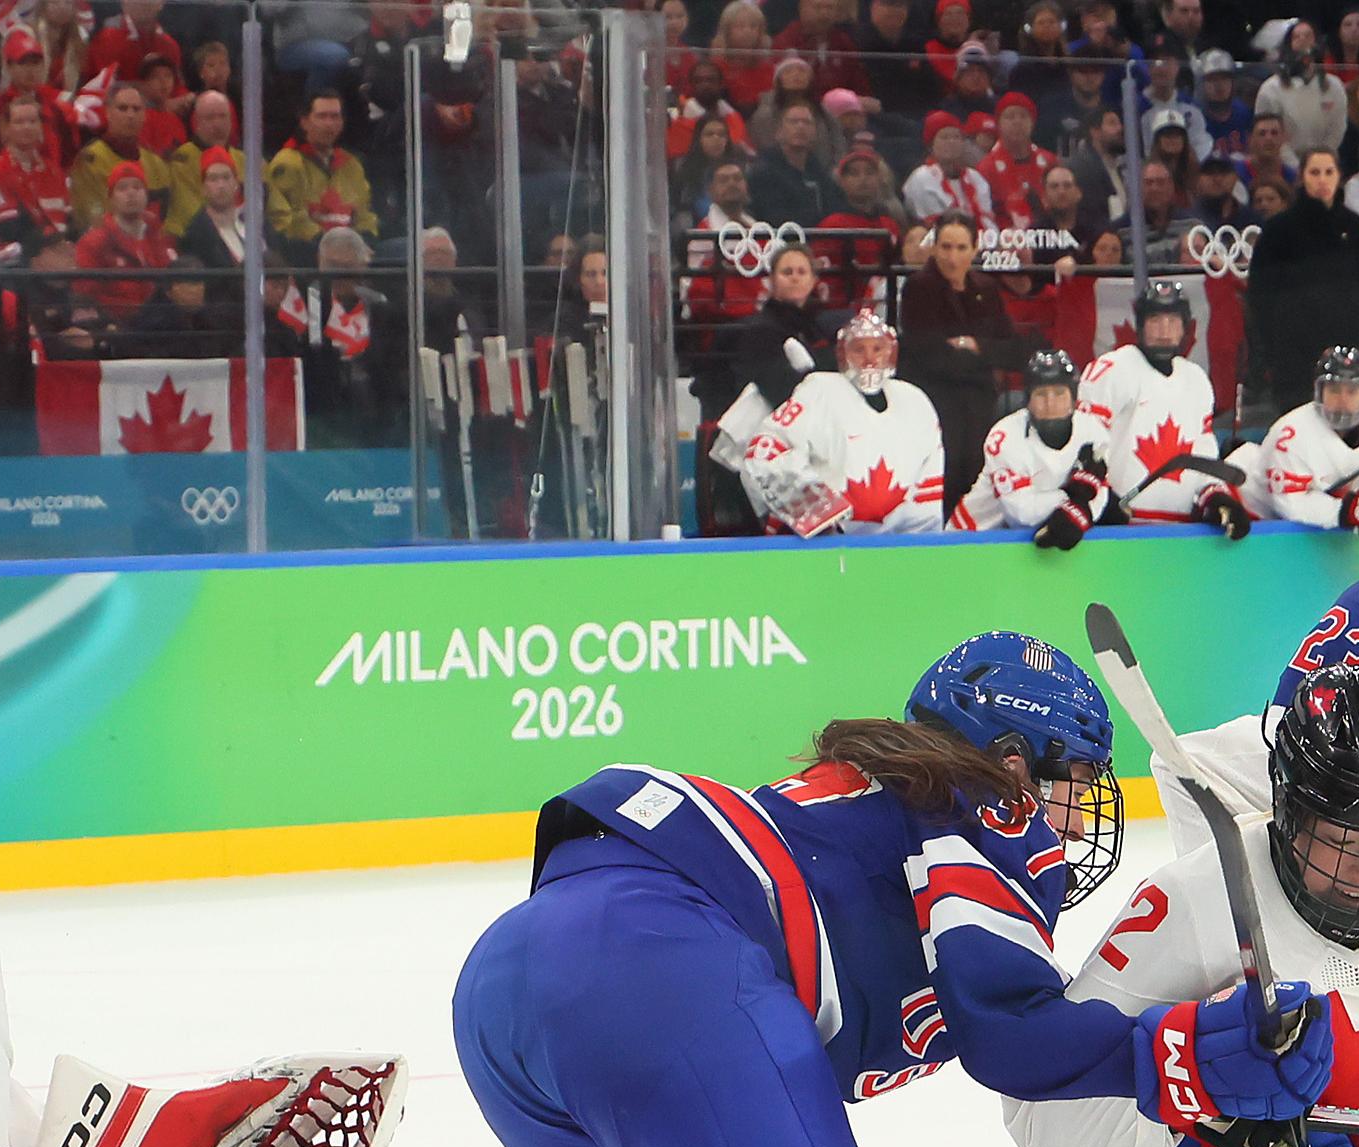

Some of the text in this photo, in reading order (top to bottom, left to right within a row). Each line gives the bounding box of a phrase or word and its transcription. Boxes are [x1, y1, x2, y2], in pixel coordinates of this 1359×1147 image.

[999, 229, 1080, 249] CORTINA
[981, 251, 1021, 272] 2026
[1084, 359, 1114, 383] 17
[986, 430, 1007, 457] 3
[1276, 425, 1296, 452] 2
[314, 615, 808, 687] MILANO CORTINA
[511, 684, 625, 740] 2026
[994, 693, 1052, 717] CCM
[1162, 1027, 1214, 1123] CM
